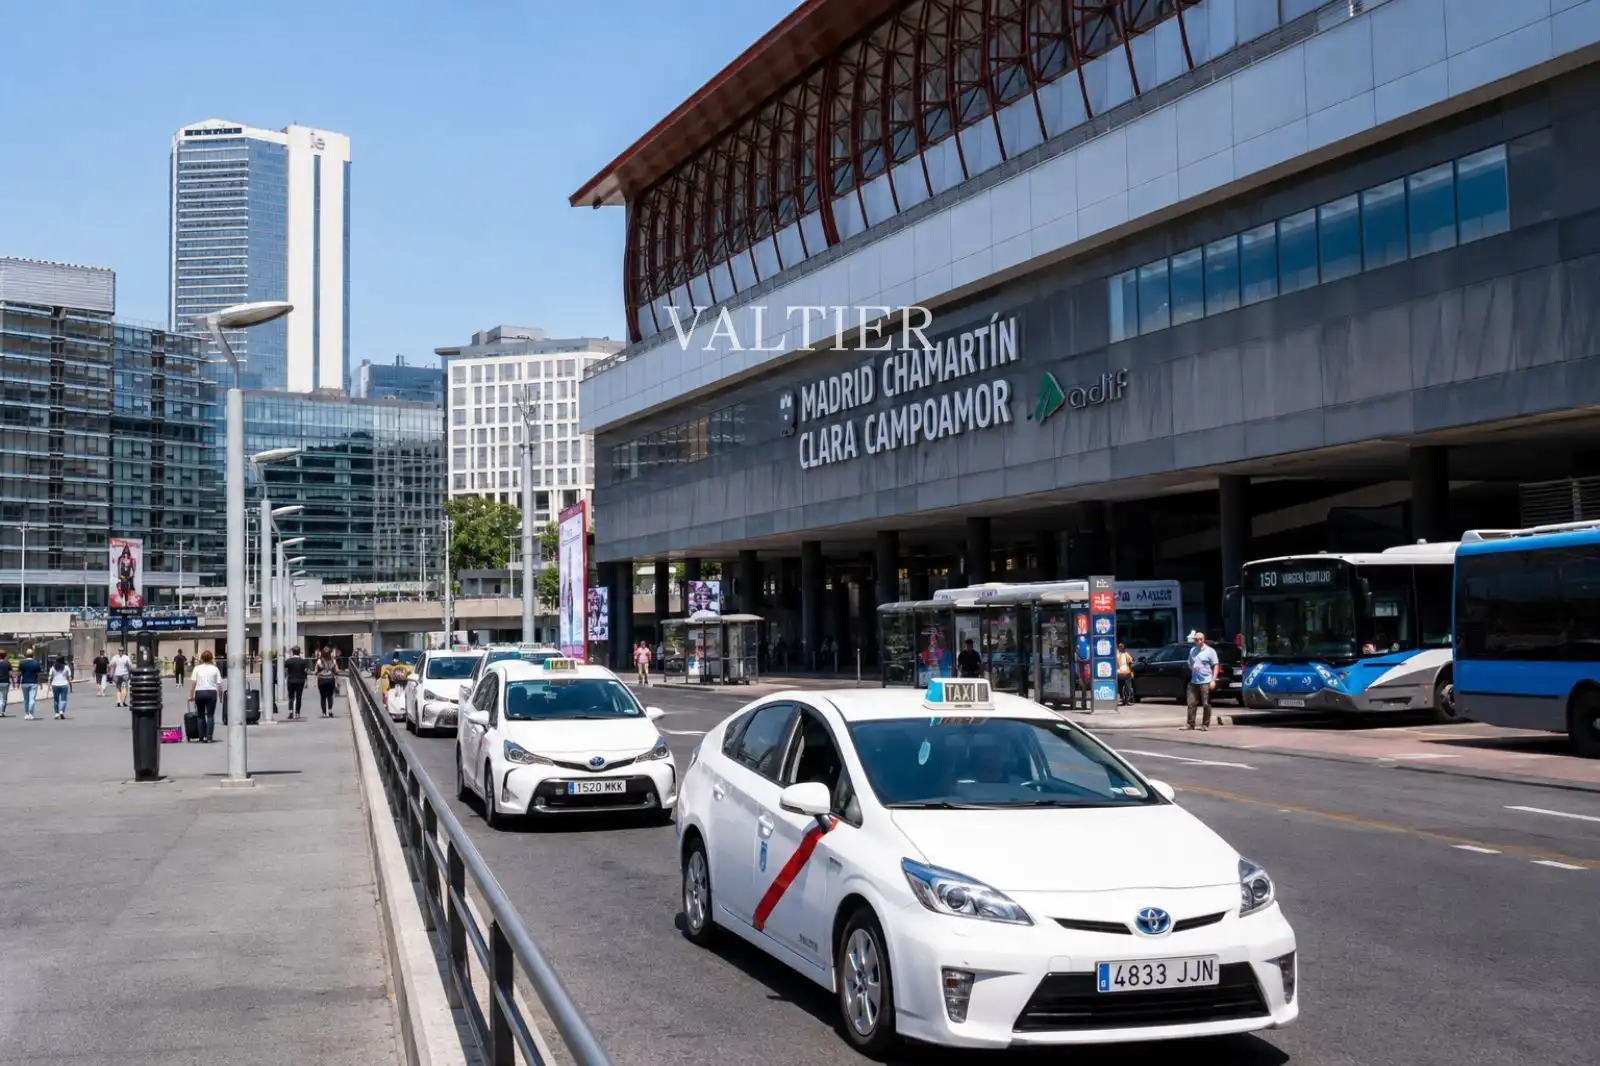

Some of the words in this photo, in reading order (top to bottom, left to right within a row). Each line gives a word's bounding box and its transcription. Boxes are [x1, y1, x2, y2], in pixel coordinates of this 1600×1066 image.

[801, 365, 875, 422] MADRID
[883, 312, 1020, 398] CHAMARTÍN
[1070, 367, 1128, 408] adif
[799, 420, 858, 470] CLARA
[864, 379, 1013, 454] CAMPOAMOR
[1260, 571, 1277, 587] 150
[945, 684, 975, 701] TAXI
[577, 783, 602, 793] 1520
[1114, 963, 1167, 987] 4833
[1177, 960, 1214, 983] JJN
